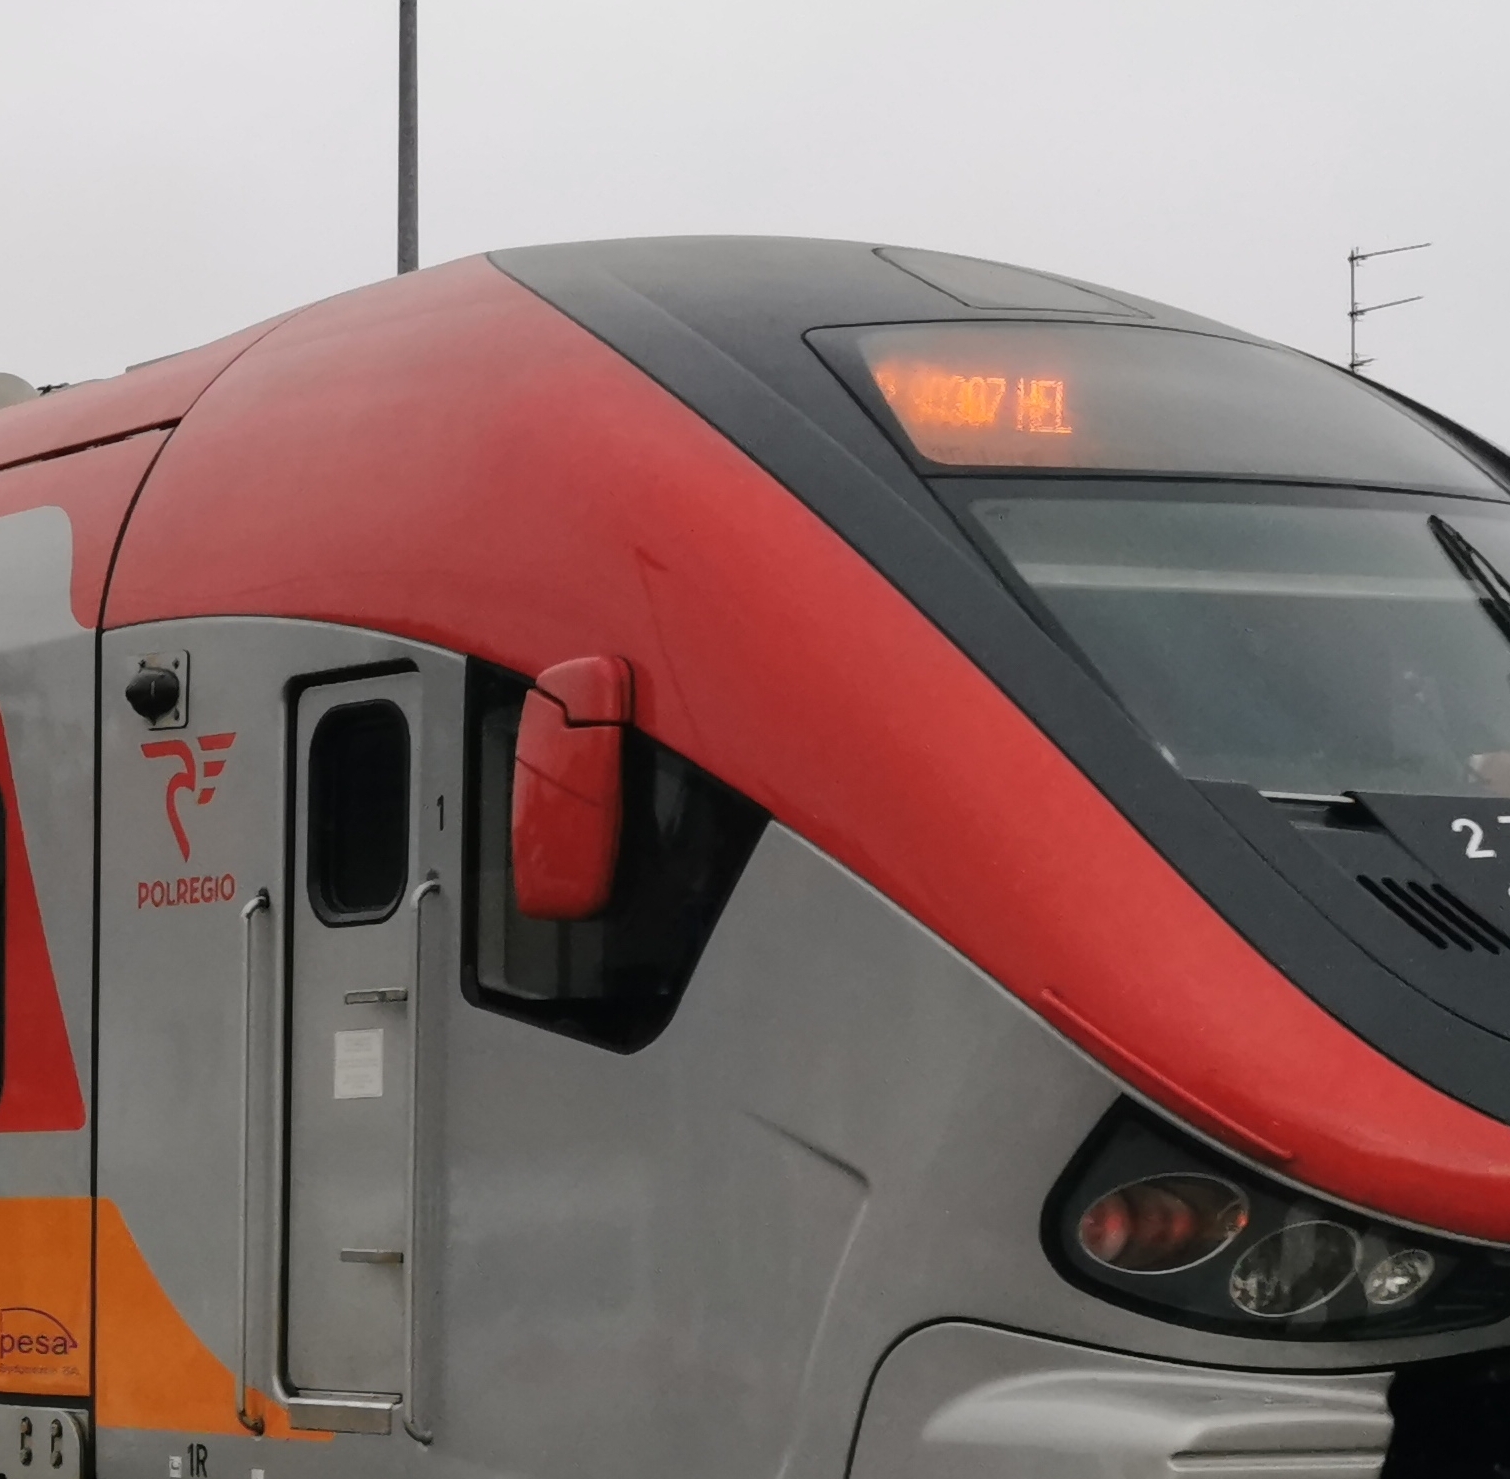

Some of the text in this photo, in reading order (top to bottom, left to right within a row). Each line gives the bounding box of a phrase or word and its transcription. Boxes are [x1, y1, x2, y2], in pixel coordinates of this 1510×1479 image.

[437, 795, 444, 831] 1
[1451, 818, 1497, 858] 2
[138, 873, 235, 909] POLREGIO
[0, 1334, 68, 1359] pesa
[187, 1443, 208, 1478] 1R
